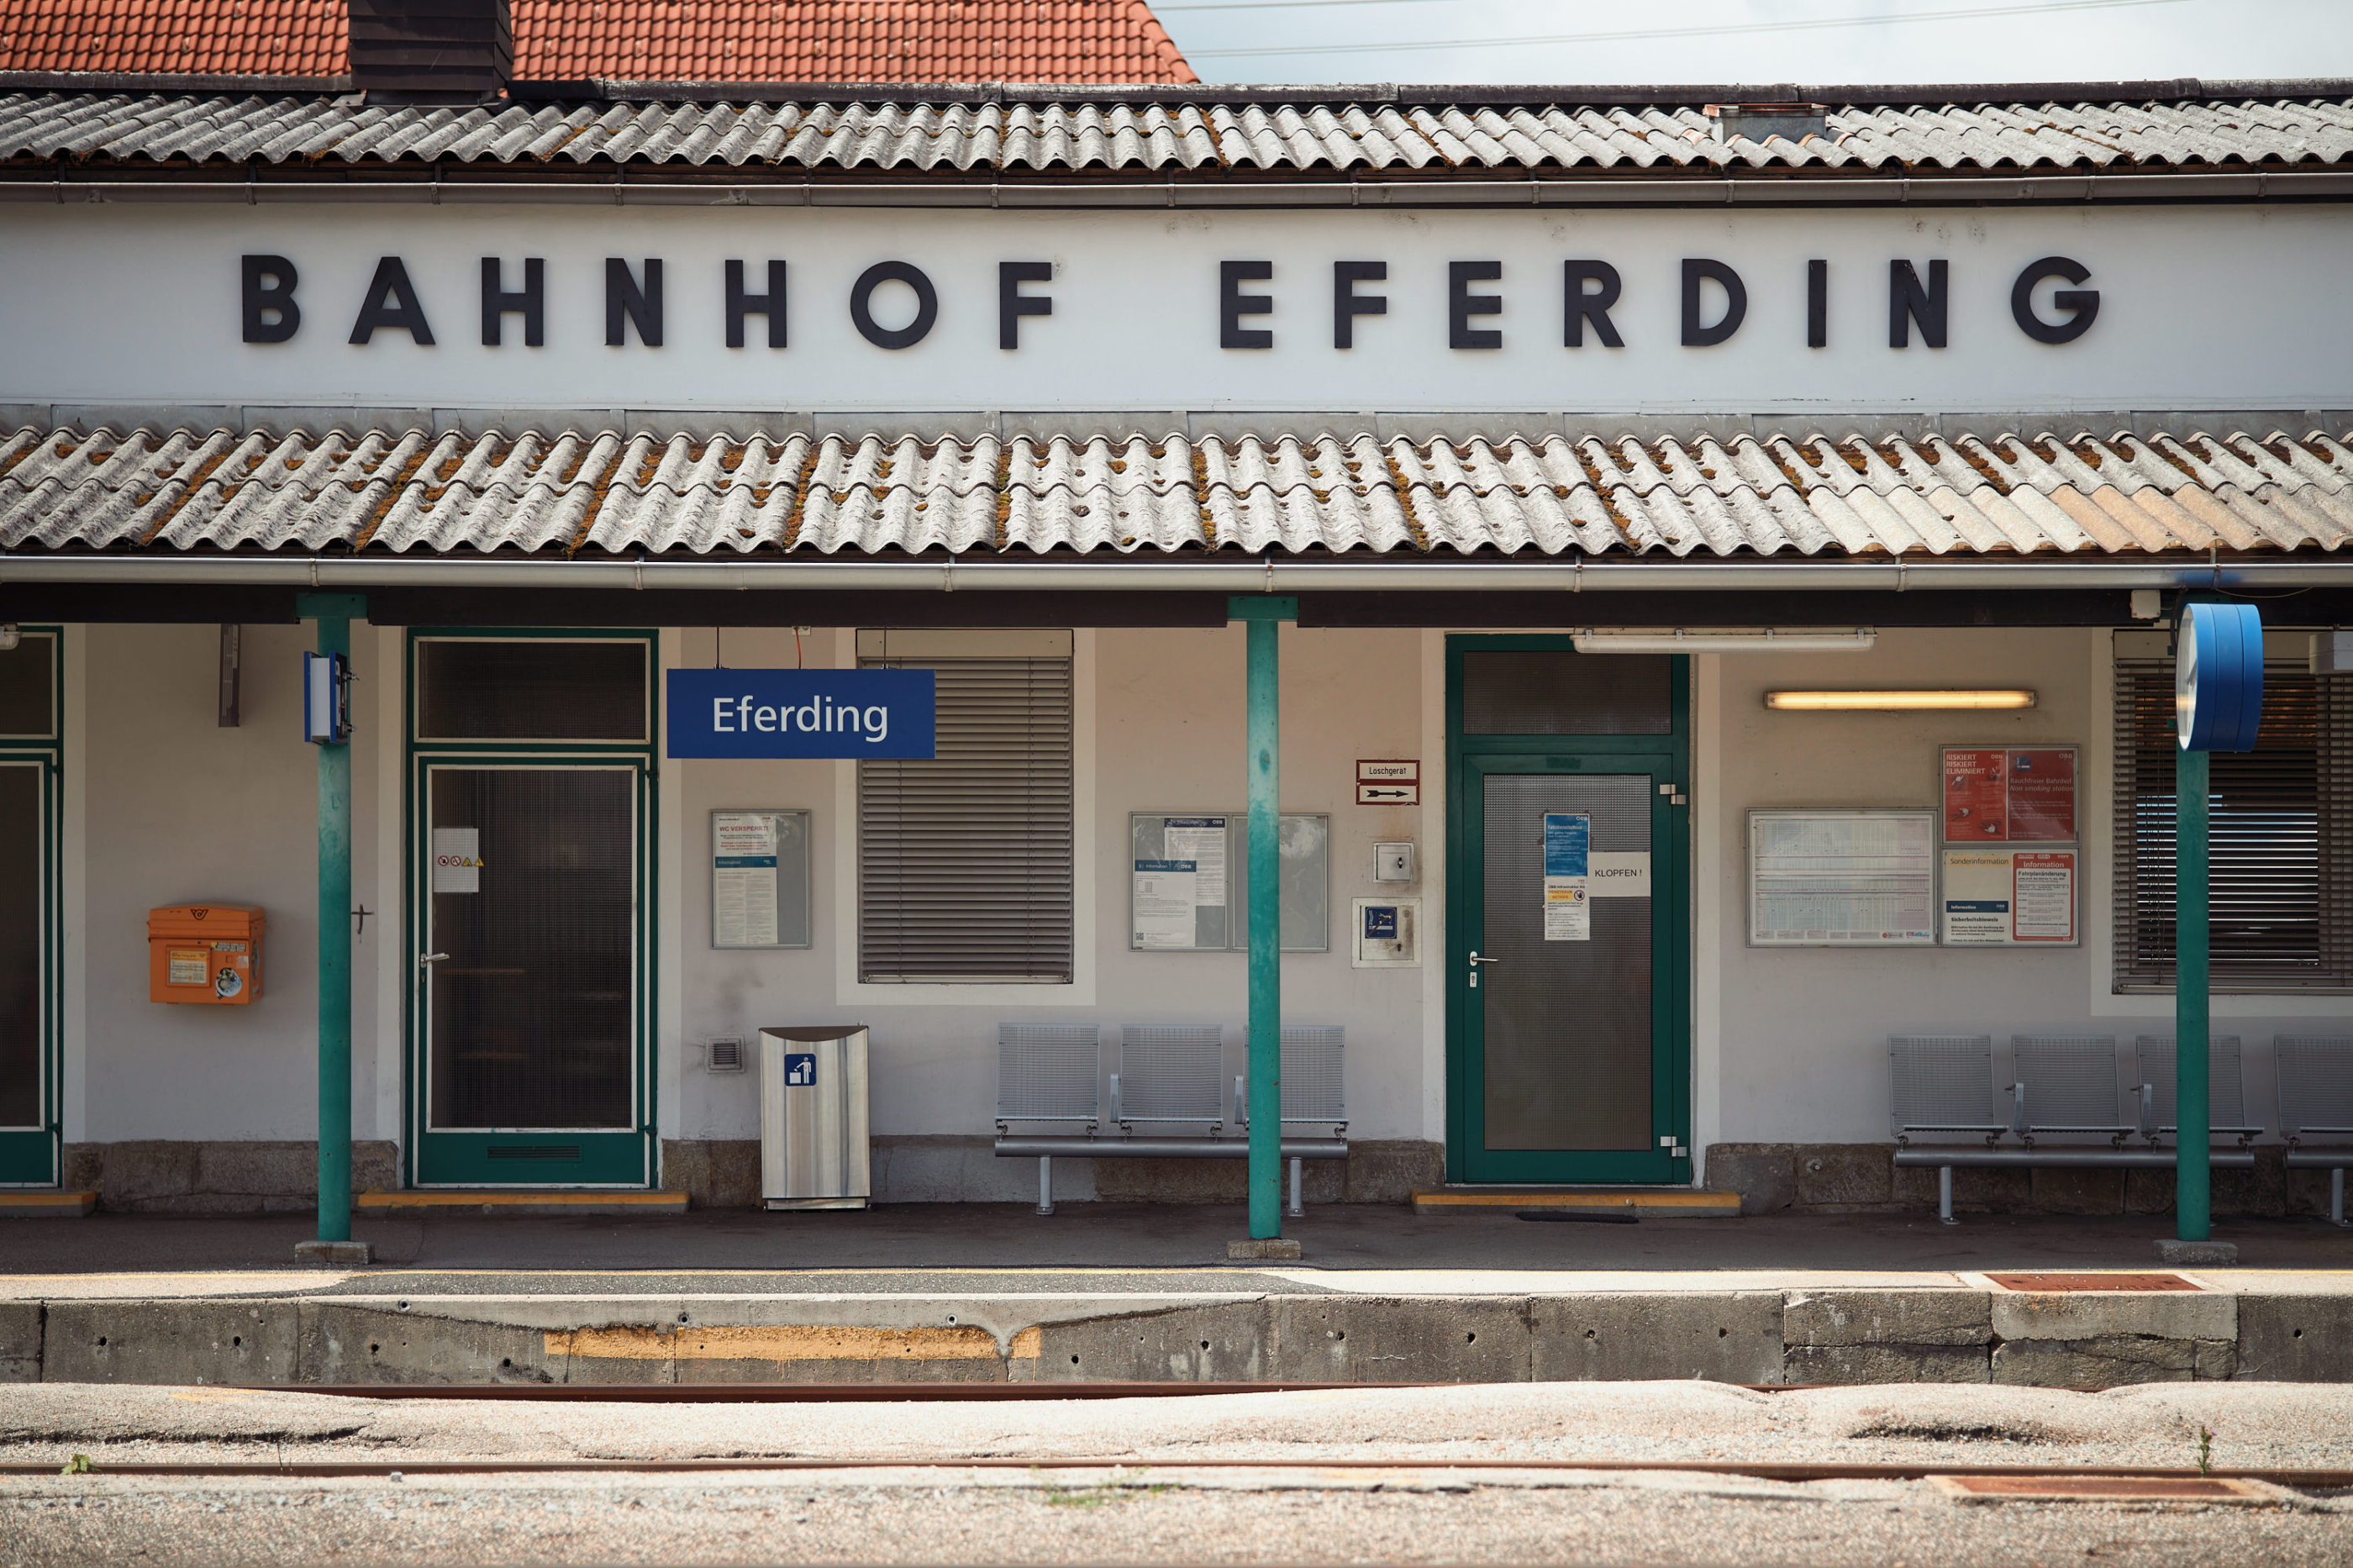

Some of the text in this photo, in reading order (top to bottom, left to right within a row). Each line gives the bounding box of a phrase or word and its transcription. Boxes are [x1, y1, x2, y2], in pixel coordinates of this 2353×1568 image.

[241, 255, 2101, 350] BAHNHOF EFERDING
[713, 695, 887, 743] Eferding
[1369, 766, 1407, 776] Löschgerät
[1950, 857, 2009, 866] Sonderinformation
[1594, 869, 1637, 877] KLOPFEN
